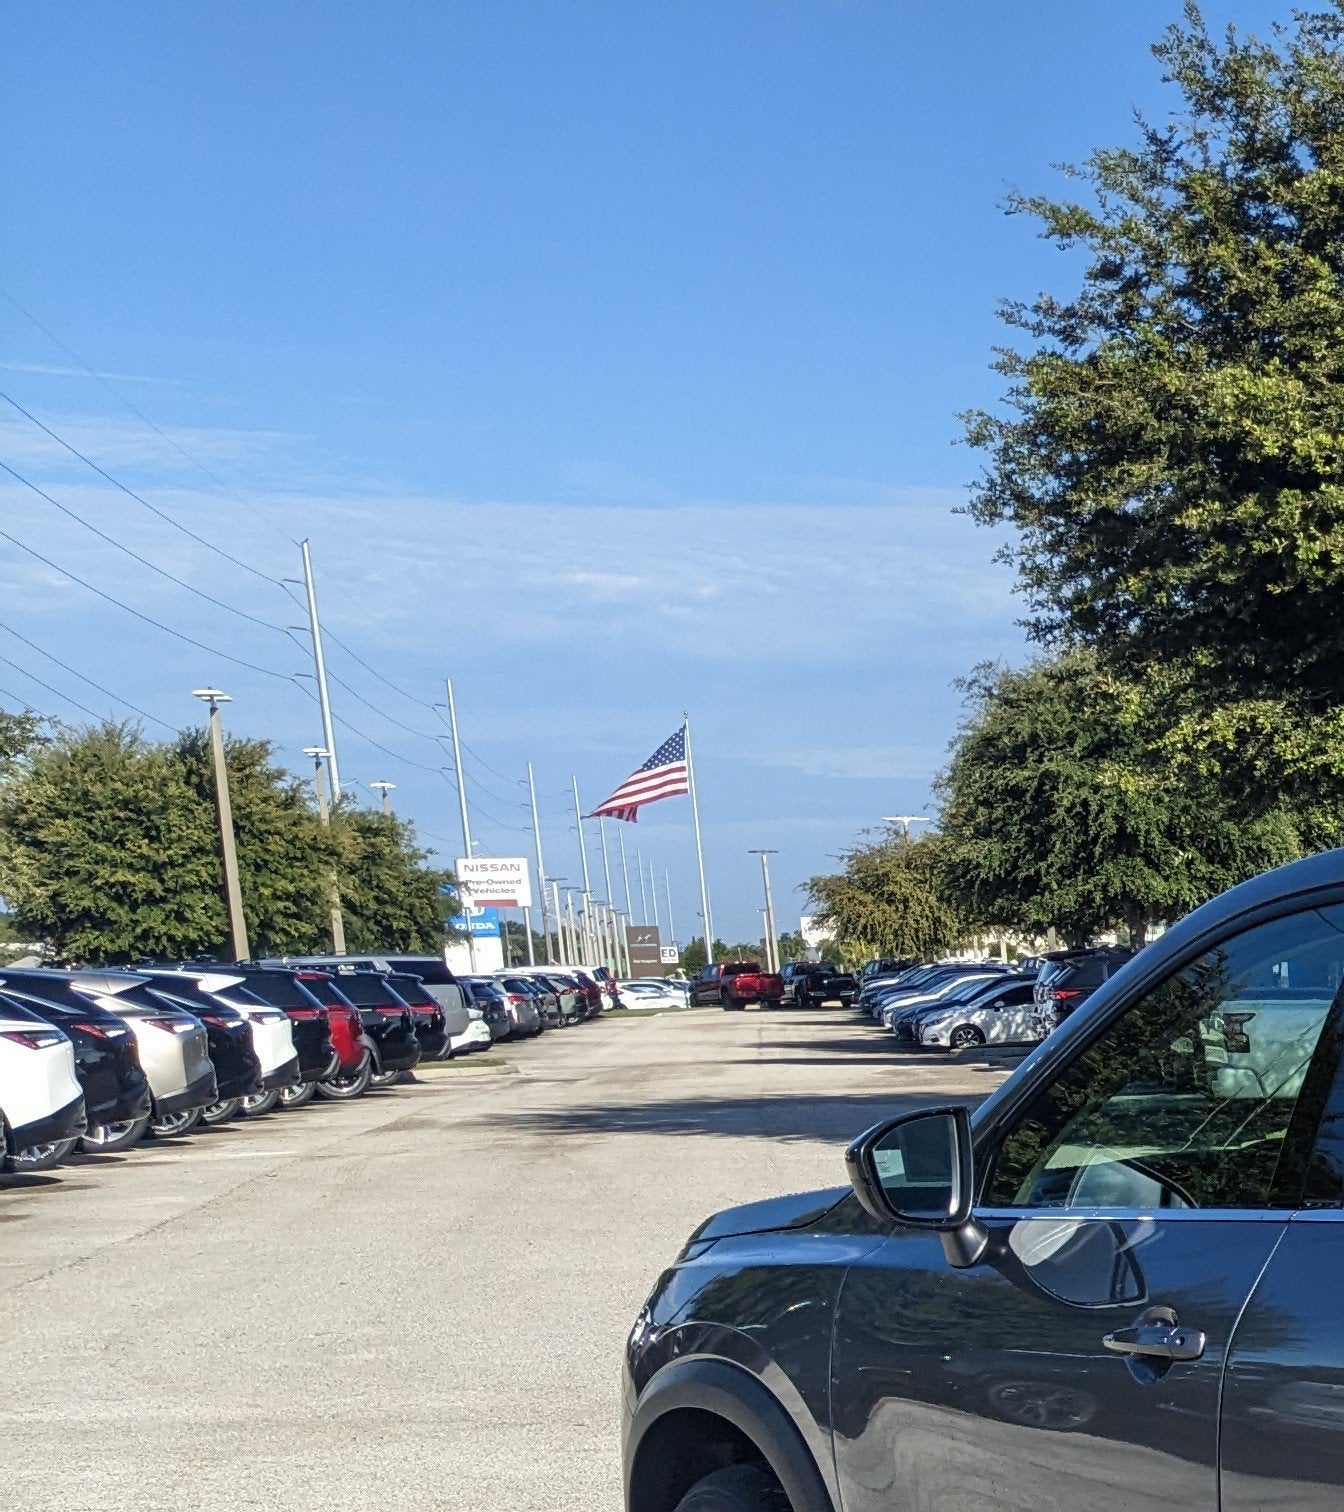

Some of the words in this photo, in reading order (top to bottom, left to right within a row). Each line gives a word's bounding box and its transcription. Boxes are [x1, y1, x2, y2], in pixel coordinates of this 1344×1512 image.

[463, 863, 521, 873] NISSAN
[466, 878, 522, 886] Pre-Owned
[661, 949, 676, 958] ED
